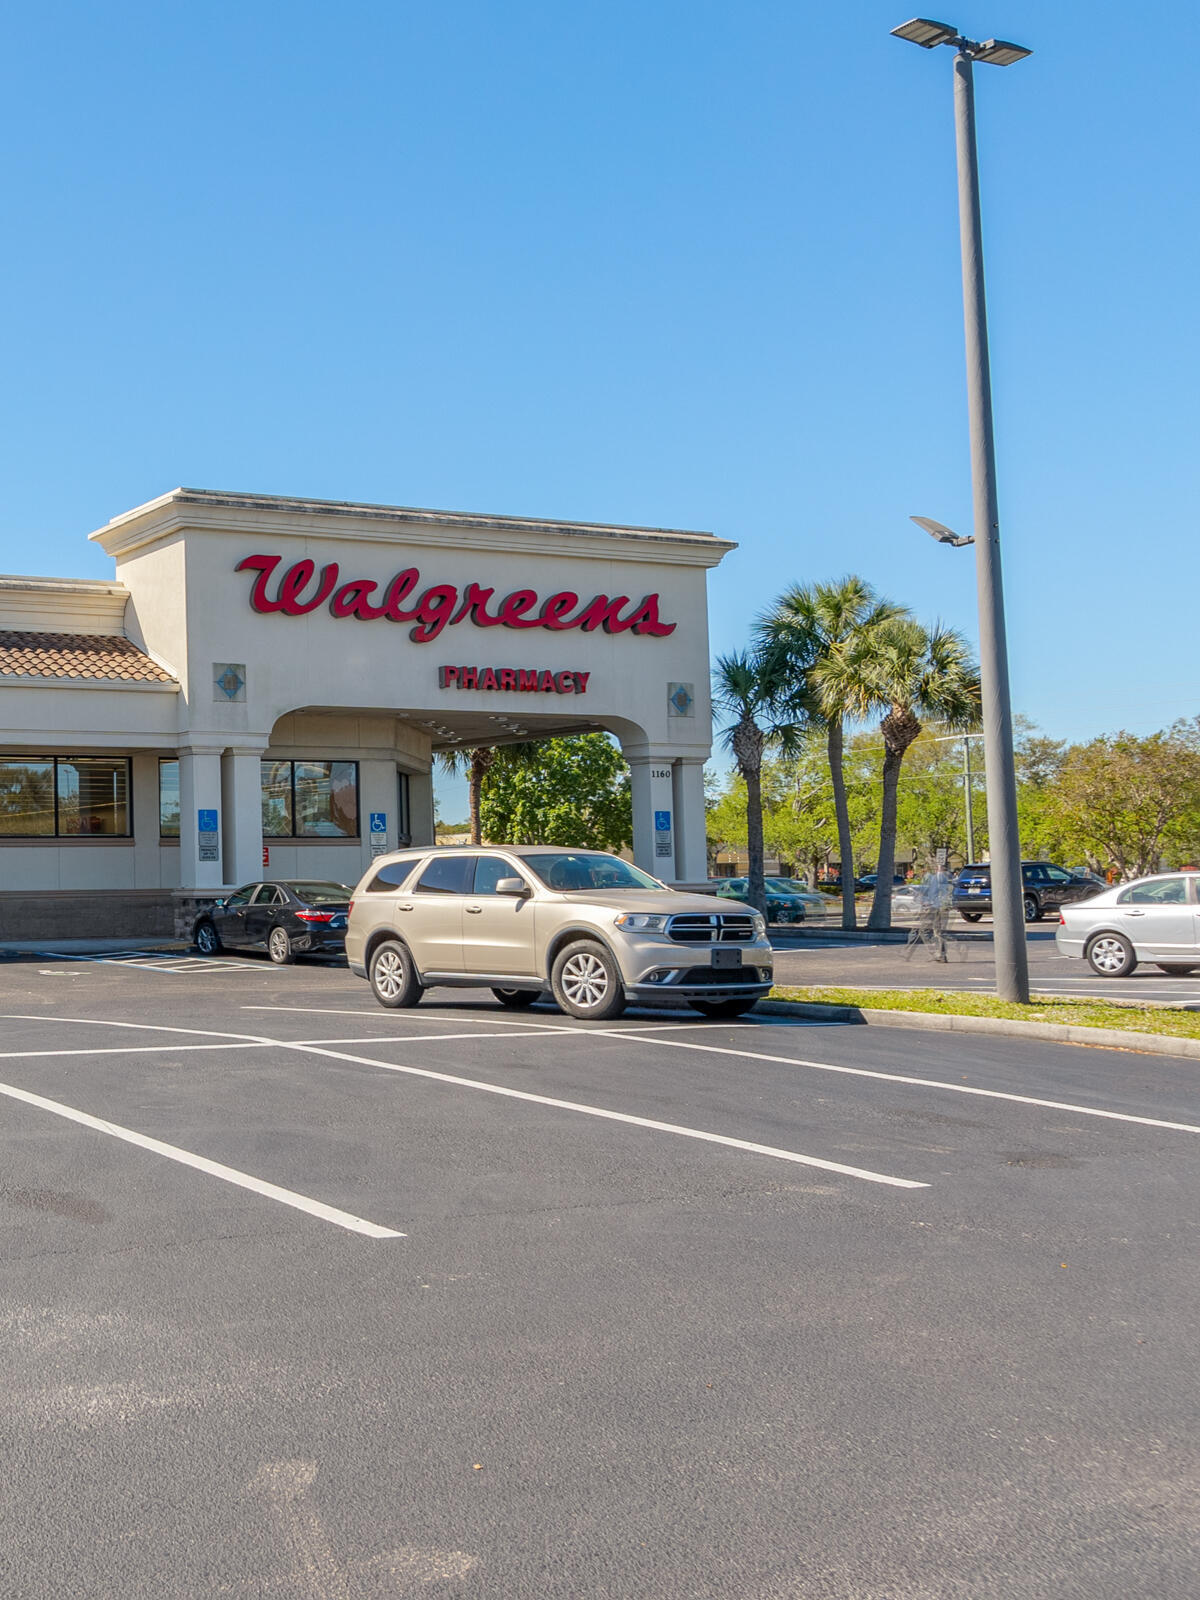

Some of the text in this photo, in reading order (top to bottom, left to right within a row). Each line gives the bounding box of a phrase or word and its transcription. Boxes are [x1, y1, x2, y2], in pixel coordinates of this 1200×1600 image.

[234, 554, 677, 643] Walgreens
[439, 665, 591, 694] PHARMACY
[652, 770, 671, 778] 1160
